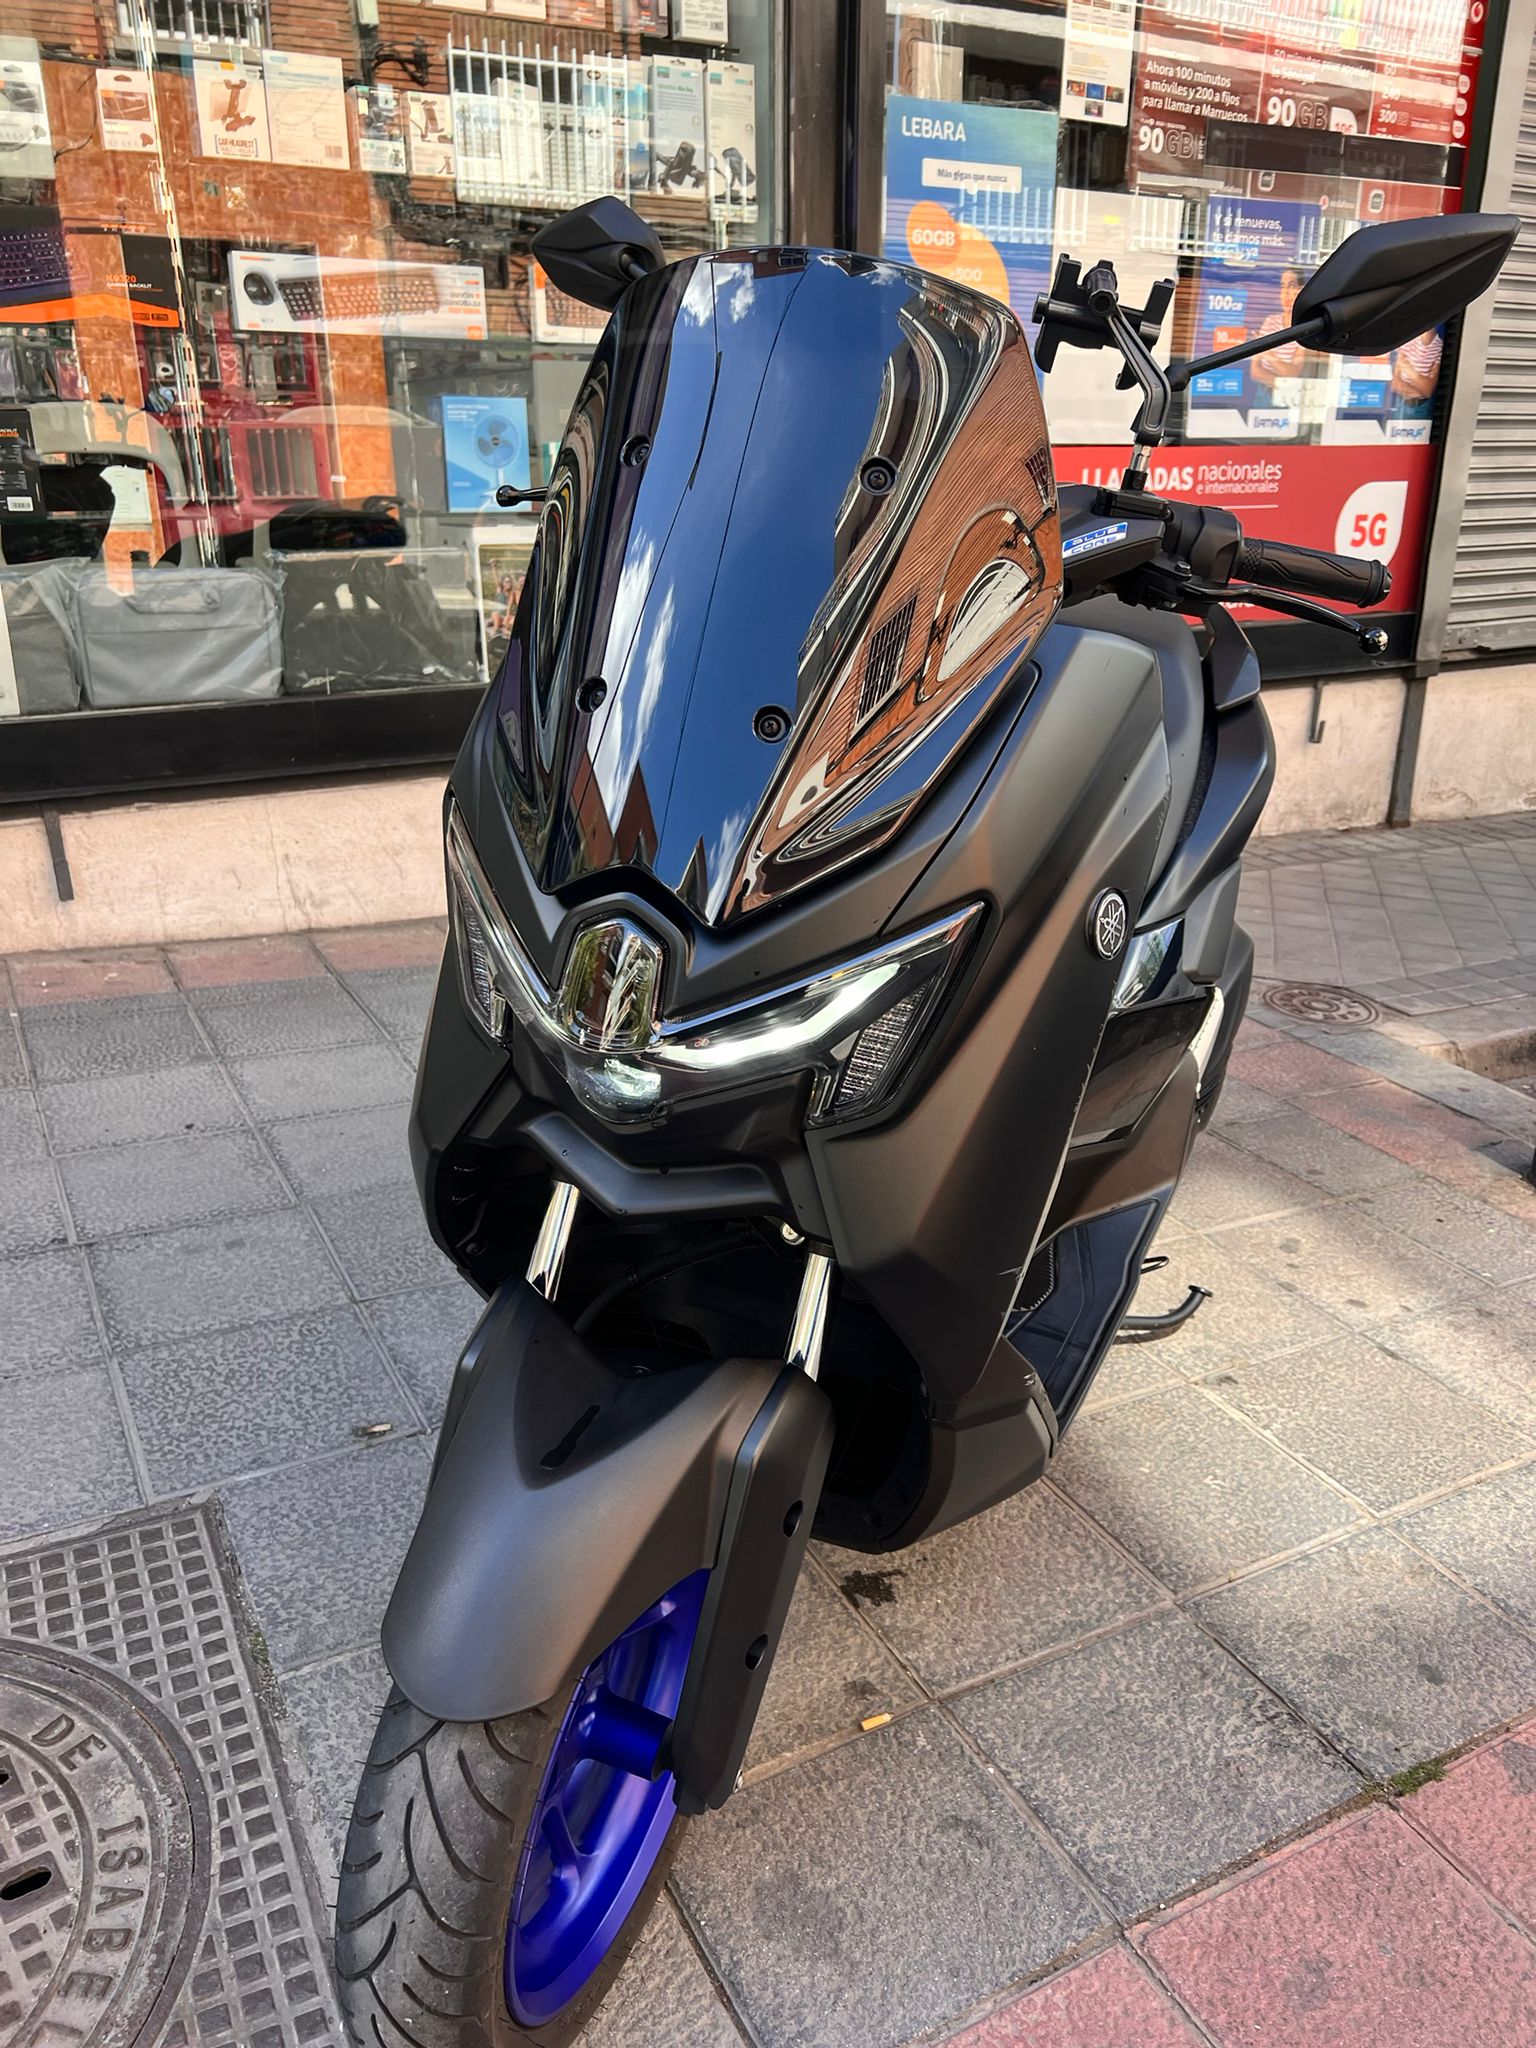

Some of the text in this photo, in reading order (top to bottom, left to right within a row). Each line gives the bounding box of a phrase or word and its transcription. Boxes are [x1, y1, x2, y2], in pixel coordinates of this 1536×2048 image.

[1145, 60, 1231, 87] Ahora 100 minutos
[1144, 79, 1240, 106] a móviles y 200 a fijos
[1142, 96, 1248, 122] para llamar a Marruecos
[902, 115, 966, 142] LEBARA
[1214, 213, 1222, 226] Y
[1235, 216, 1283, 232] renuevas,
[912, 229, 956, 247] 60GB
[1212, 231, 1223, 242] te
[1224, 231, 1260, 244] damos
[1081, 460, 1282, 491] LLAADAS nacionales
[1196, 481, 1280, 494] e internacionales
[1072, 527, 1118, 545] BLUE
[1350, 513, 1388, 547] 5G
[1072, 536, 1117, 554] CORE
[31, 1713, 107, 1772] DE
